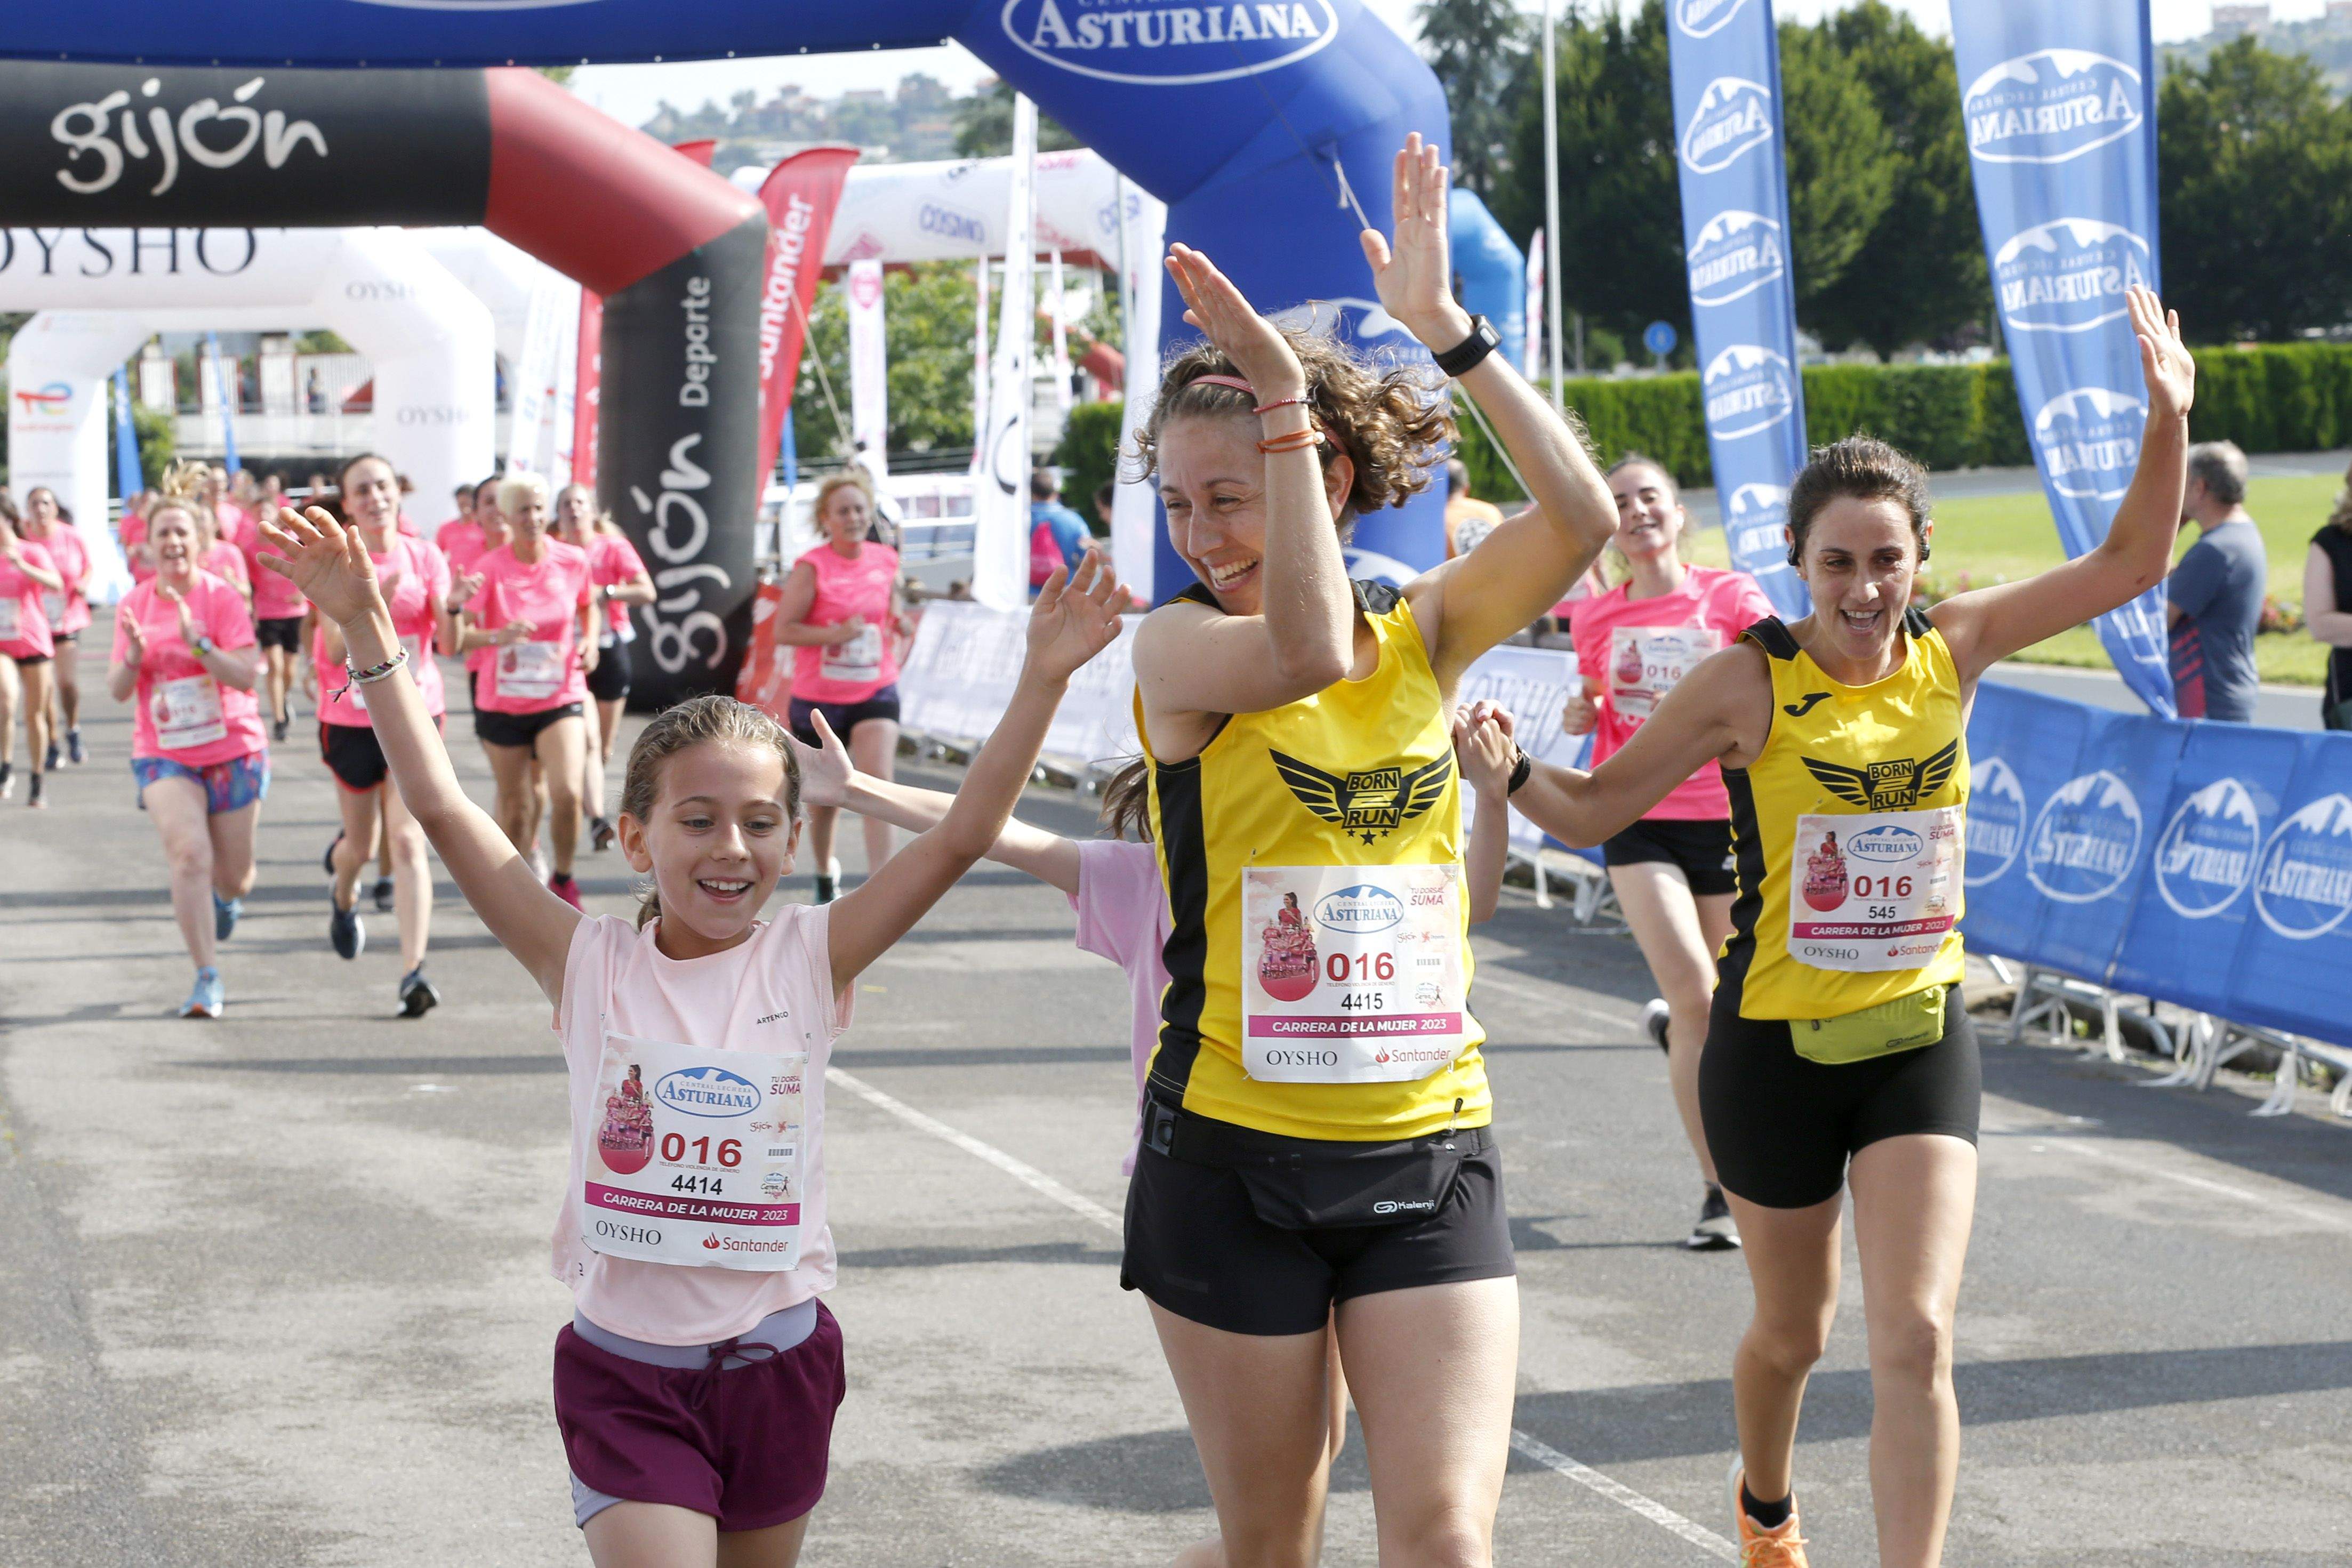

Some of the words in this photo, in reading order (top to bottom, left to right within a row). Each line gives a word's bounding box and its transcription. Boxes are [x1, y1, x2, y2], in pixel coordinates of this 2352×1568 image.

[1031, 0, 1321, 49] ASTURIANA
[50, 76, 328, 196] gijón
[0, 226, 258, 278] YSHO
[680, 276, 718, 407] Deporte
[631, 433, 731, 673] gijón
[1871, 762, 1913, 779] BORN
[1348, 771, 1398, 790] BORN
[1872, 791, 1915, 808] RUN
[1347, 809, 1398, 826] RUN
[1929, 829, 1955, 840] SUMA
[1853, 839, 1918, 853] ASTURIANA
[1853, 875, 1913, 898] 016
[1410, 895, 1444, 906] SUMA
[1321, 903, 1399, 922] ASTURIANA
[1868, 906, 1896, 919] 545
[1811, 927, 1859, 935] CARRERA
[1877, 927, 1891, 935] LA
[1893, 923, 1923, 934] MUJER
[1924, 920, 1946, 930] 2023
[1804, 946, 1859, 960] OYSHO
[1326, 952, 1394, 981] 016
[1341, 993, 1383, 1010] 4415
[1272, 1022, 1337, 1033] CARRERA
[1340, 1022, 1358, 1033] DE
[1359, 1022, 1375, 1033] LA
[1377, 1019, 1417, 1032] MUJER
[1420, 1018, 1447, 1031] 2023
[1266, 1050, 1338, 1066] OYSHO
[1392, 1049, 1451, 1063] Santander
[662, 1081, 753, 1108] ASTURIANA
[680, 1081, 714, 1091] CENTRAL
[717, 1084, 751, 1093] LECHERA
[769, 1083, 801, 1095] SUMA
[661, 1132, 743, 1168] 016
[671, 1175, 723, 1195] 4414
[603, 1192, 664, 1213] CARRERA
[667, 1203, 687, 1215] DE
[689, 1204, 708, 1216] LA
[711, 1208, 758, 1220] MUJER
[761, 1210, 789, 1220] 2023
[1398, 1199, 1435, 1210] Kalenji
[596, 1220, 662, 1245] OYSHO
[723, 1237, 789, 1252] Santander
